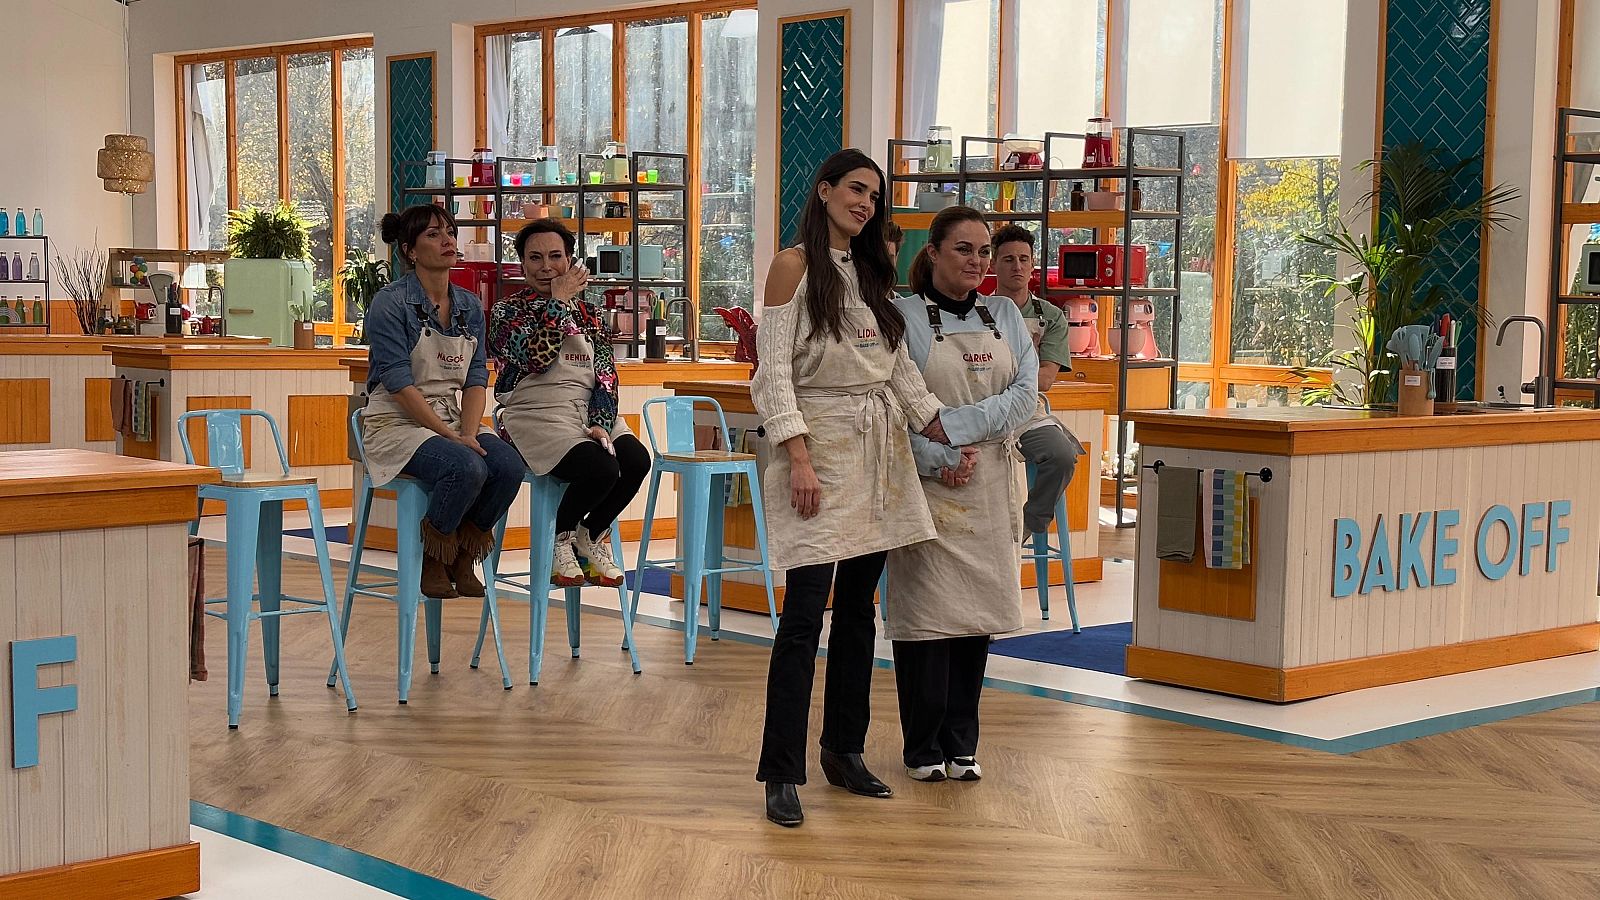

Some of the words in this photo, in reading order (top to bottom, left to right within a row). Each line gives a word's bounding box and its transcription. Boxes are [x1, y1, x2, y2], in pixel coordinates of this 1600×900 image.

[565, 353, 591, 362] BENITA
[857, 328, 877, 339] LIDIA
[1331, 509, 1459, 598] BAKE
[1474, 499, 1571, 580] OFF
[8, 633, 78, 769] F
